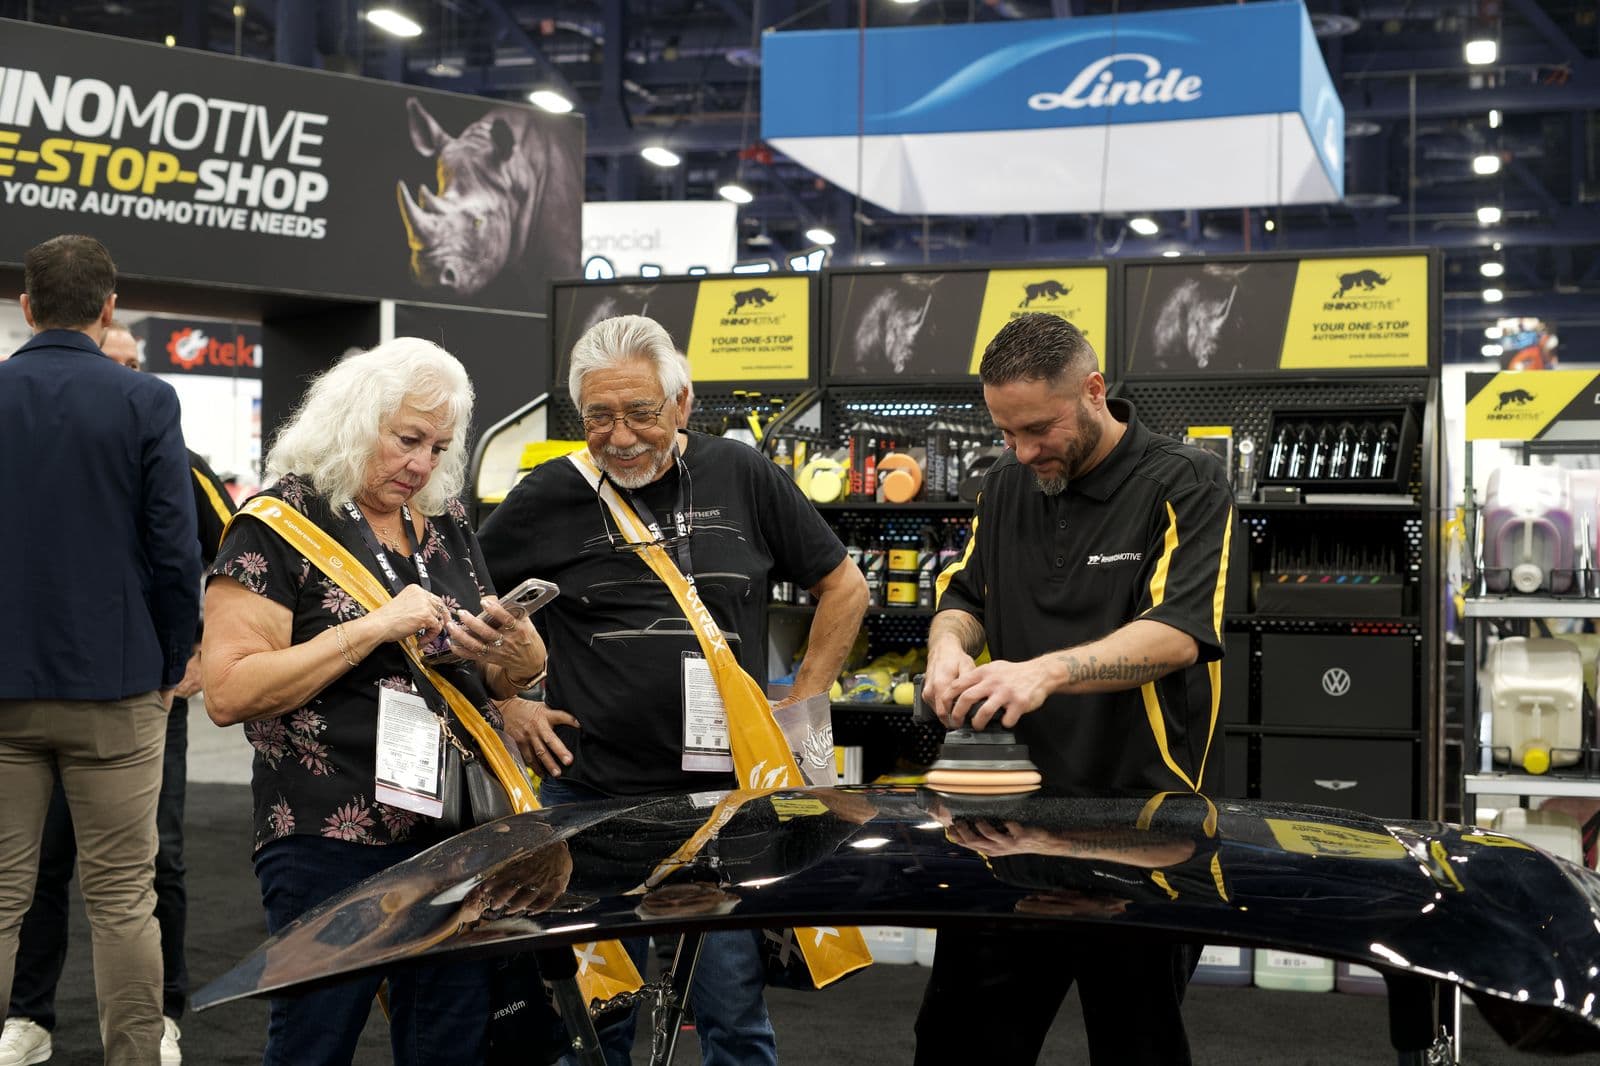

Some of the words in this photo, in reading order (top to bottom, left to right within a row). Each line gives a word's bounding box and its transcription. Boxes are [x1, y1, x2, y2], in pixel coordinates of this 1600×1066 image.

[1028, 52, 1202, 111] Linde
[0, 67, 328, 167] INOMOTIVE
[3, 181, 77, 211] YOUR
[80, 191, 248, 230] AUTOMOTIVE
[250, 211, 327, 239] NEEDS
[583, 230, 661, 252] ancial
[1322, 299, 1394, 311] RHINOMOTIVE
[1312, 321, 1344, 333] YOUR
[1347, 320, 1409, 332] ONE-STOP
[711, 335, 738, 346] YOUR
[741, 334, 793, 345] ONE-STOP
[1311, 333, 1366, 341] AUTOMOTIVE
[1367, 331, 1409, 340] SOLUTION
